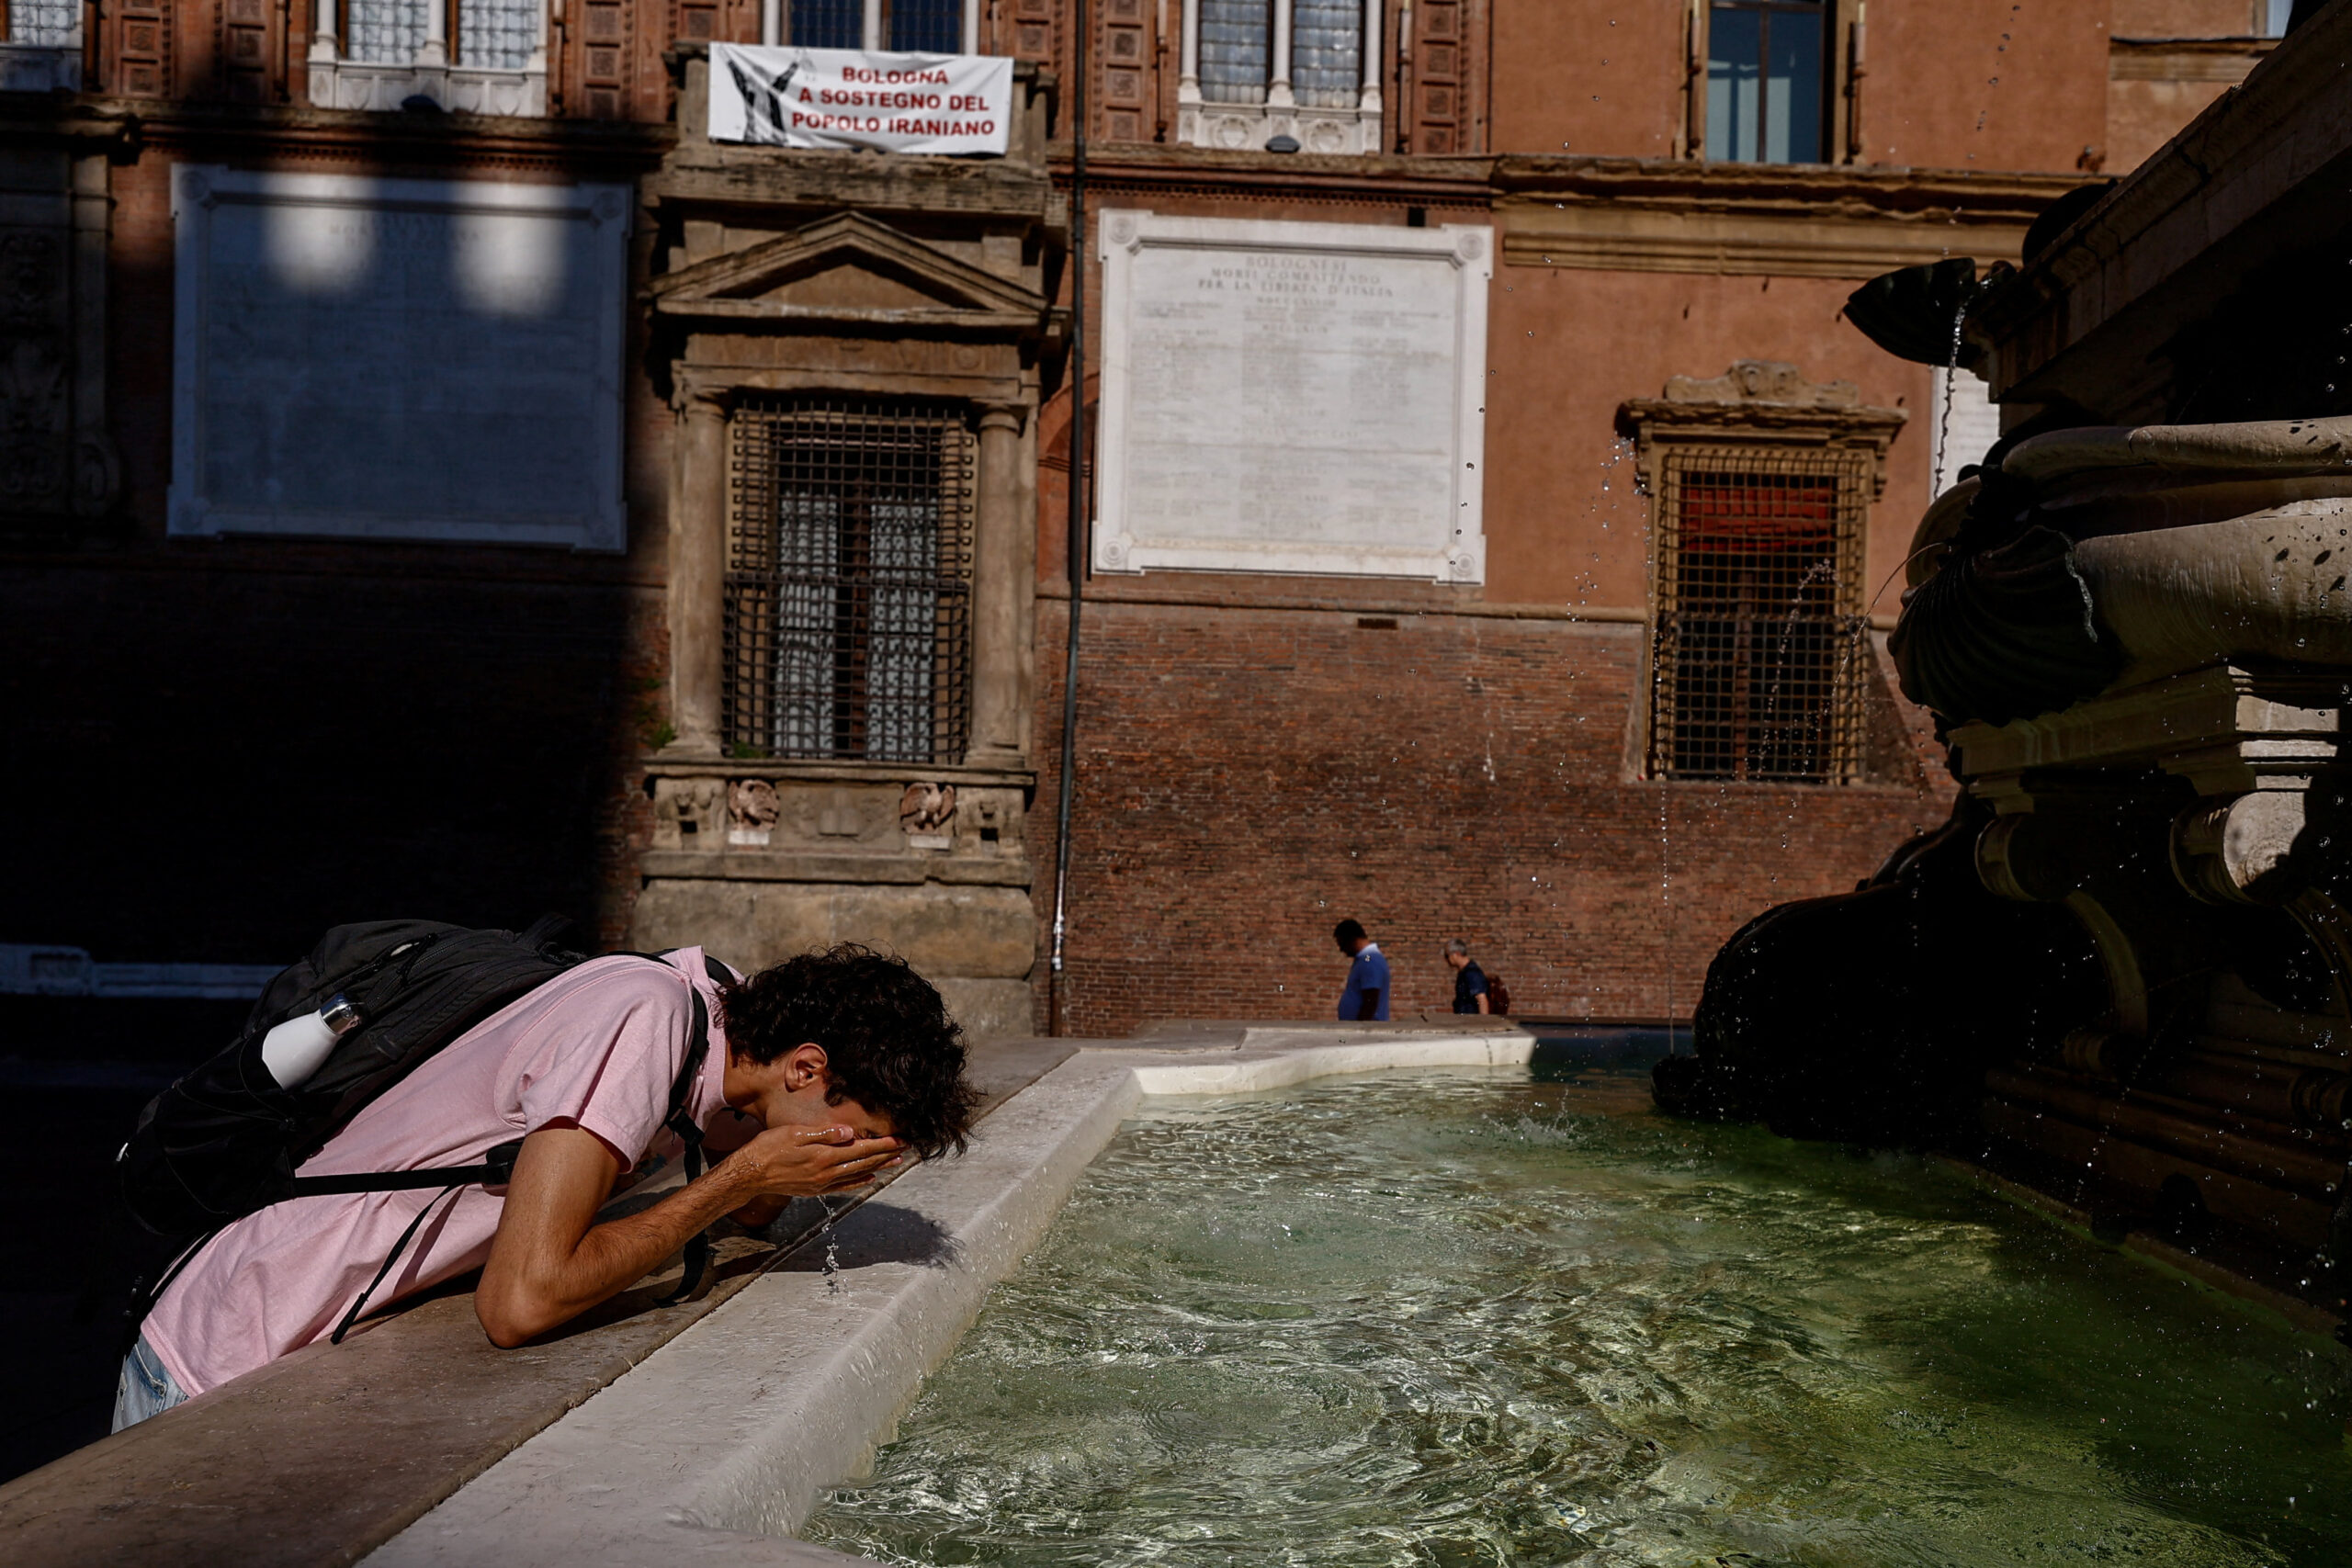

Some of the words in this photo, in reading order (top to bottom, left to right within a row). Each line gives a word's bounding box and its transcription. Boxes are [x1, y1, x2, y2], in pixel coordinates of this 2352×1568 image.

[842, 66, 950, 85] BOLOGNA
[798, 86, 813, 103] A
[820, 89, 942, 110] SOSTEGNO
[949, 95, 990, 111] DEL
[791, 112, 880, 133] POPOLO
[888, 118, 995, 136] IRANIANO
[1245, 255, 1348, 272] BOLOGNESI
